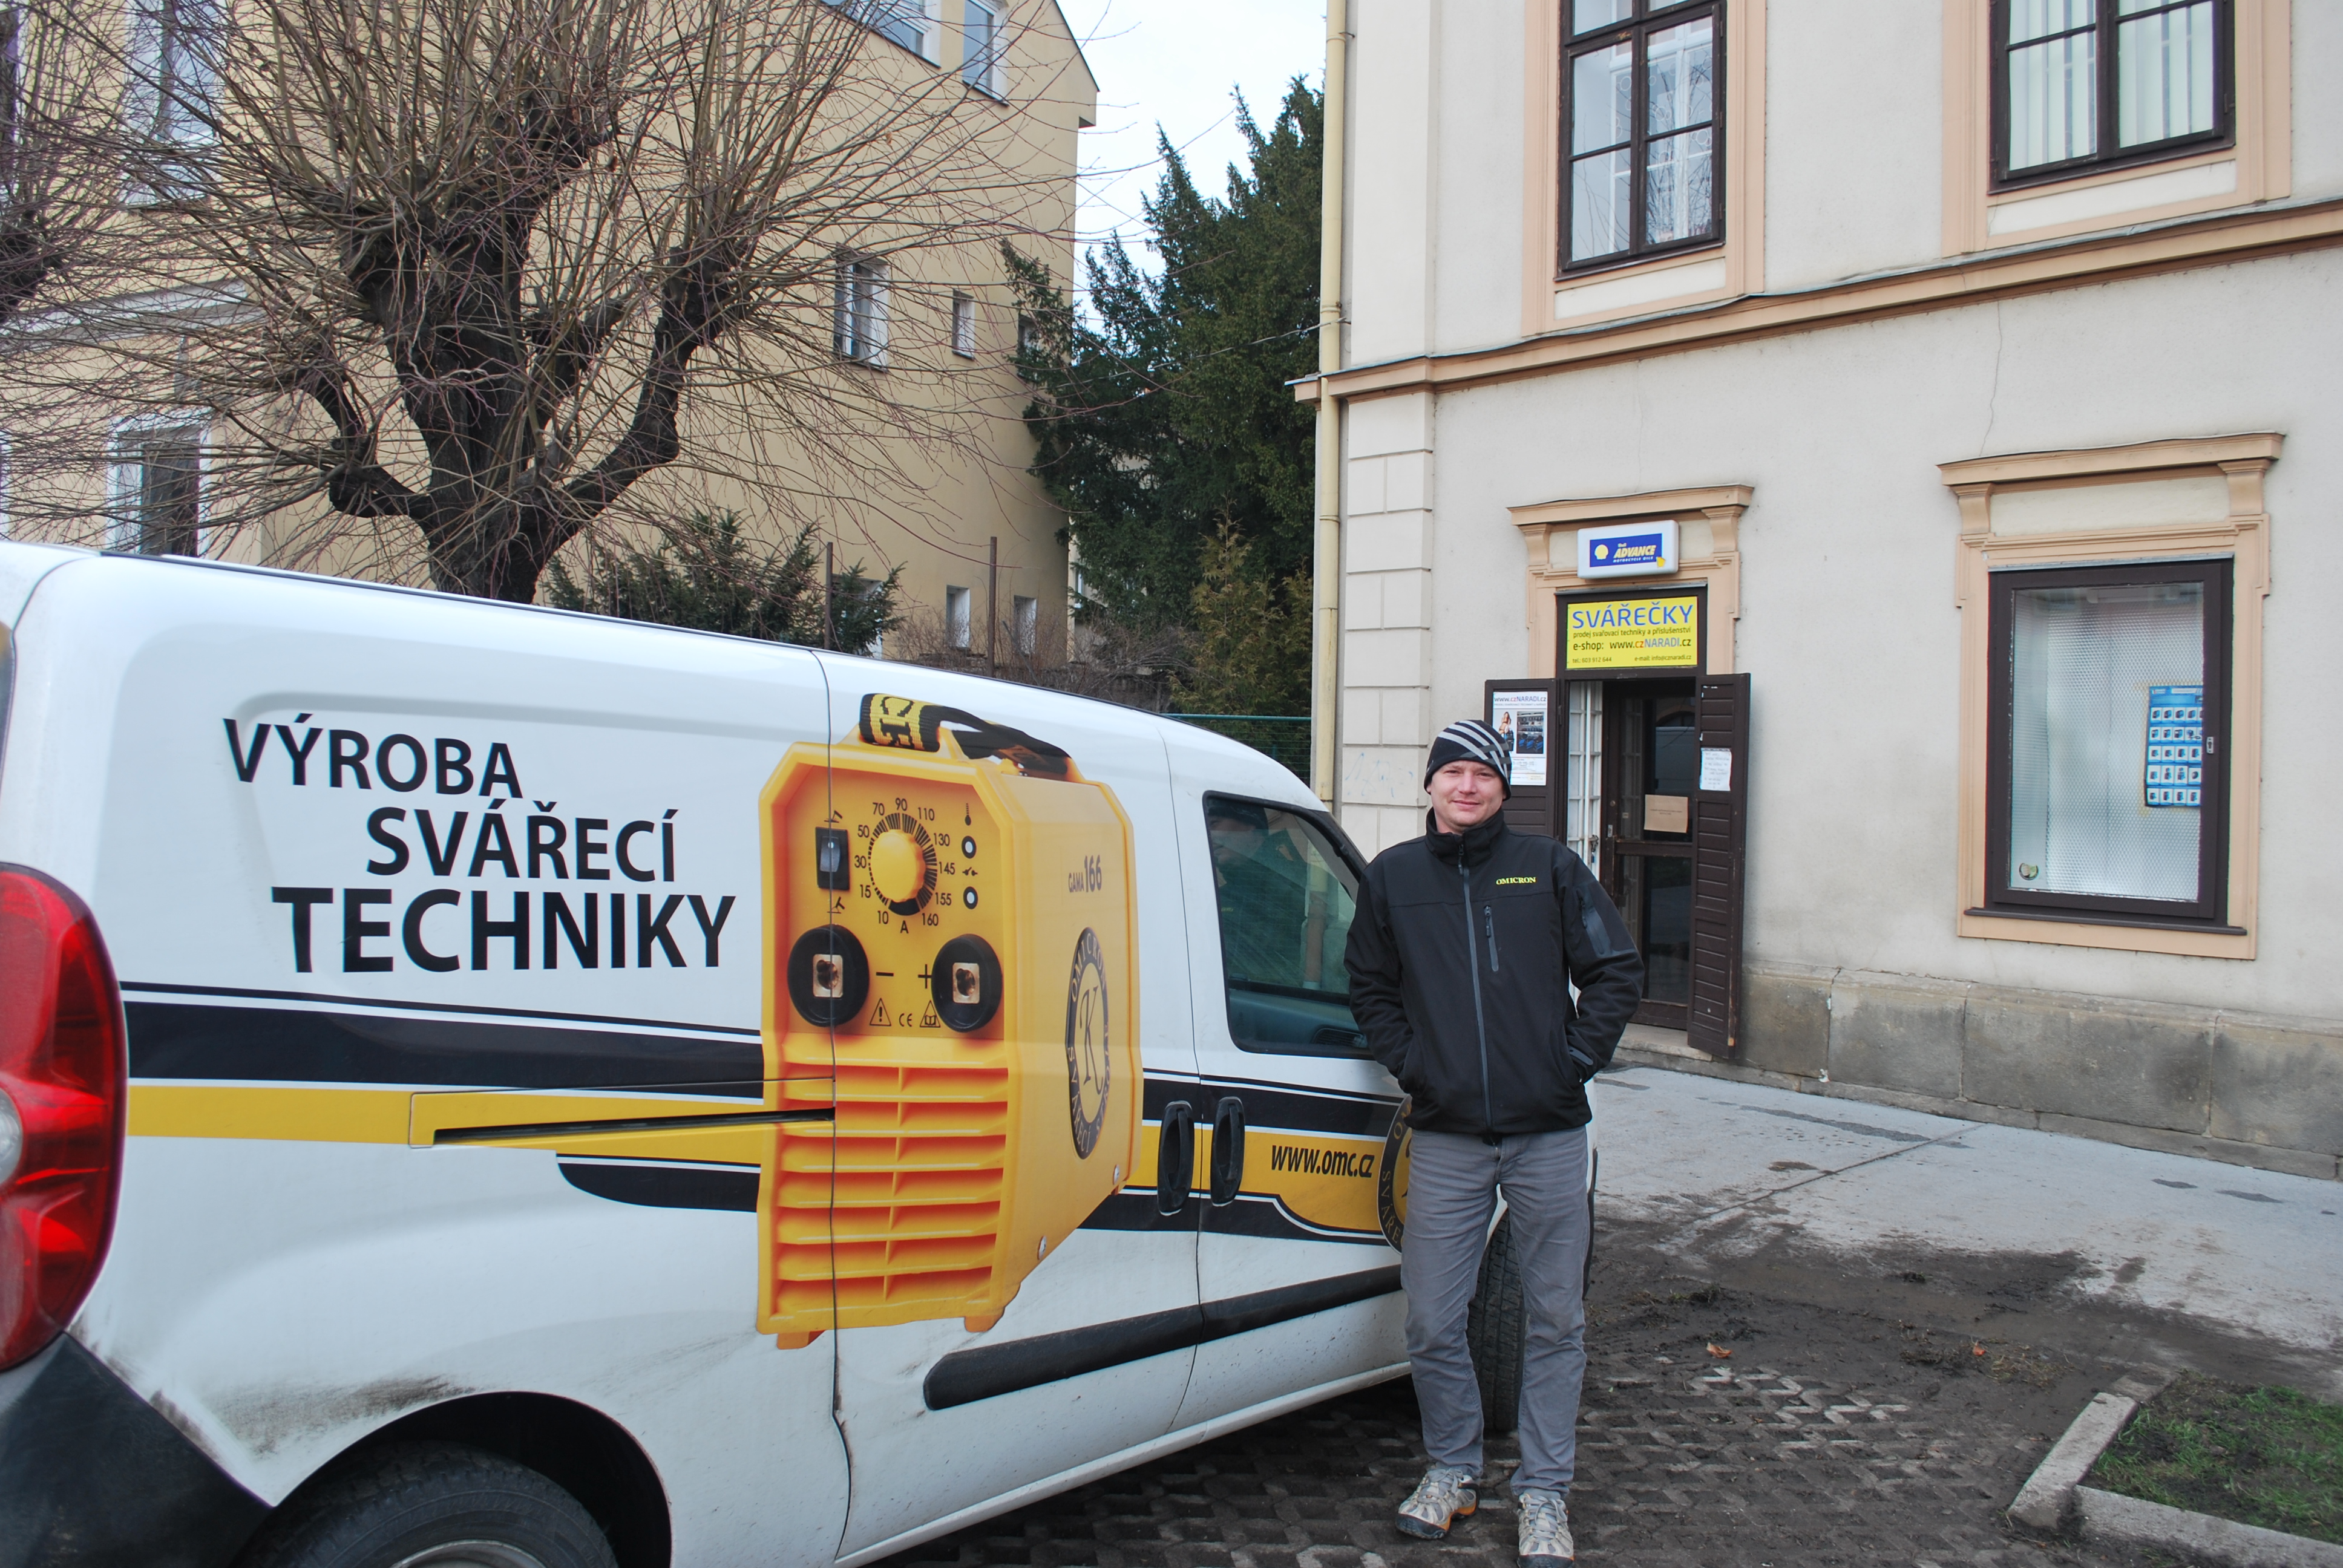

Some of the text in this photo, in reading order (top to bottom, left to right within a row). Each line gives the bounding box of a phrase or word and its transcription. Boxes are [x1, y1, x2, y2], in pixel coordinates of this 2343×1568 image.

[1613, 544, 1656, 558] ADVANCE
[1573, 601, 1693, 629] SVÁŘEČKY
[1573, 630, 1591, 639] prodej
[1573, 637, 1691, 652] e-shop: www.czNARADI.cz
[223, 713, 523, 799] VÝROBA
[873, 802, 885, 816] 70
[895, 798, 908, 811] 90
[918, 808, 935, 821] 110
[857, 826, 870, 838] 50
[367, 799, 678, 882] SVÁŘECÍ
[934, 833, 950, 846] 130
[854, 855, 867, 869] 30
[939, 861, 955, 875] 145
[1069, 855, 1102, 892] GAMA 166
[1496, 877, 1536, 885] OMICRON
[860, 885, 871, 898] 15
[935, 893, 952, 906] 155
[877, 911, 889, 924] 10
[922, 913, 939, 926] 160
[272, 887, 736, 973] TECHNIKY
[900, 920, 909, 934] A
